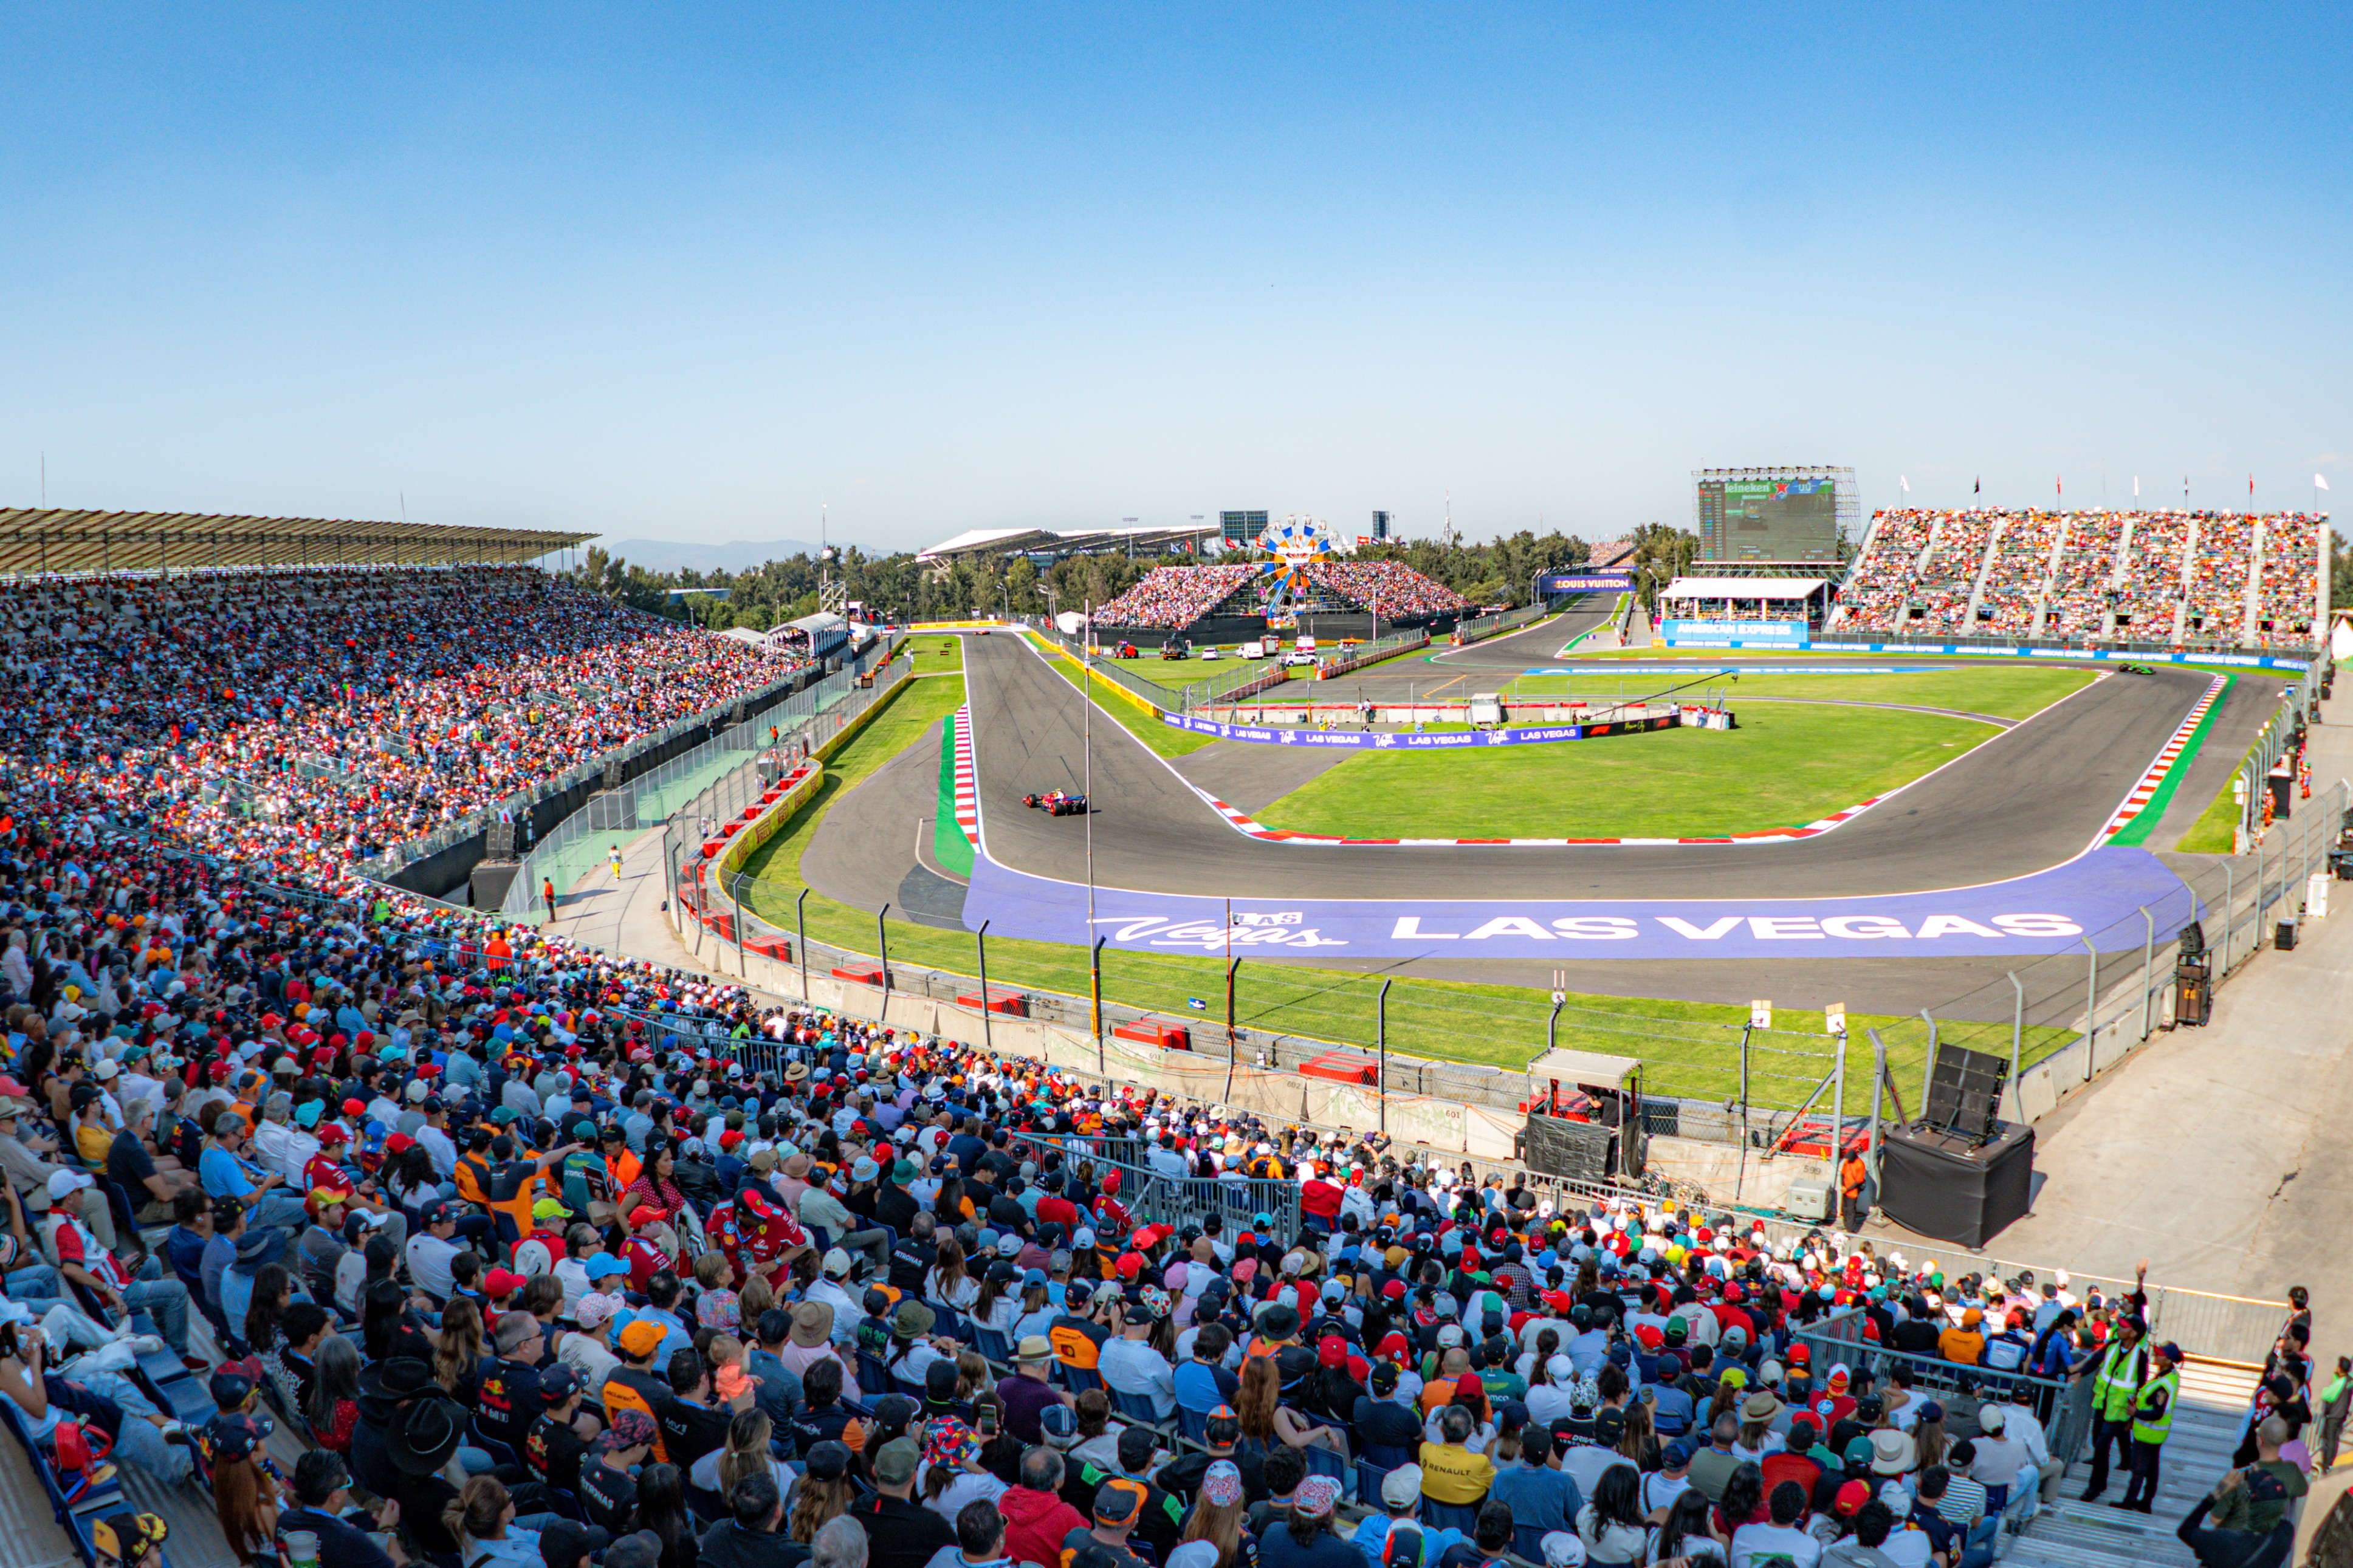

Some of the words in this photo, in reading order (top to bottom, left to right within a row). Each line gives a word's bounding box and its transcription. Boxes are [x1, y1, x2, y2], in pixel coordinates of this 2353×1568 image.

[1556, 580, 1585, 589] LOUIS
[1587, 578, 1629, 588] VUITTON
[1677, 624, 1736, 634] AMERICAN
[1737, 625, 1791, 635] EXPRESS
[2225, 656, 2260, 666] EXPRESS
[1203, 723, 1216, 733] VEGAS
[1247, 731, 1271, 740] VEGAS
[1306, 734, 1324, 743] LAS
[1325, 735, 1360, 744] VEGAS
[1432, 734, 1471, 744] VEGAS
[1520, 730, 1541, 740] LAS
[1544, 728, 1576, 738] VEGAS
[755, 820, 771, 845] PIRELLI
[1391, 917, 1638, 939] LAS
[1654, 913, 2083, 939] VEGAS
[1087, 916, 1348, 950] Vegas
[1446, 1110, 1460, 1118] 601
[1804, 1165, 1821, 1175] 599
[894, 1250, 923, 1268] PETRONAS
[1488, 1394, 1510, 1403] mco
[1572, 1434, 1596, 1445] DRIVE
[1429, 1464, 1471, 1476] RENAULT
